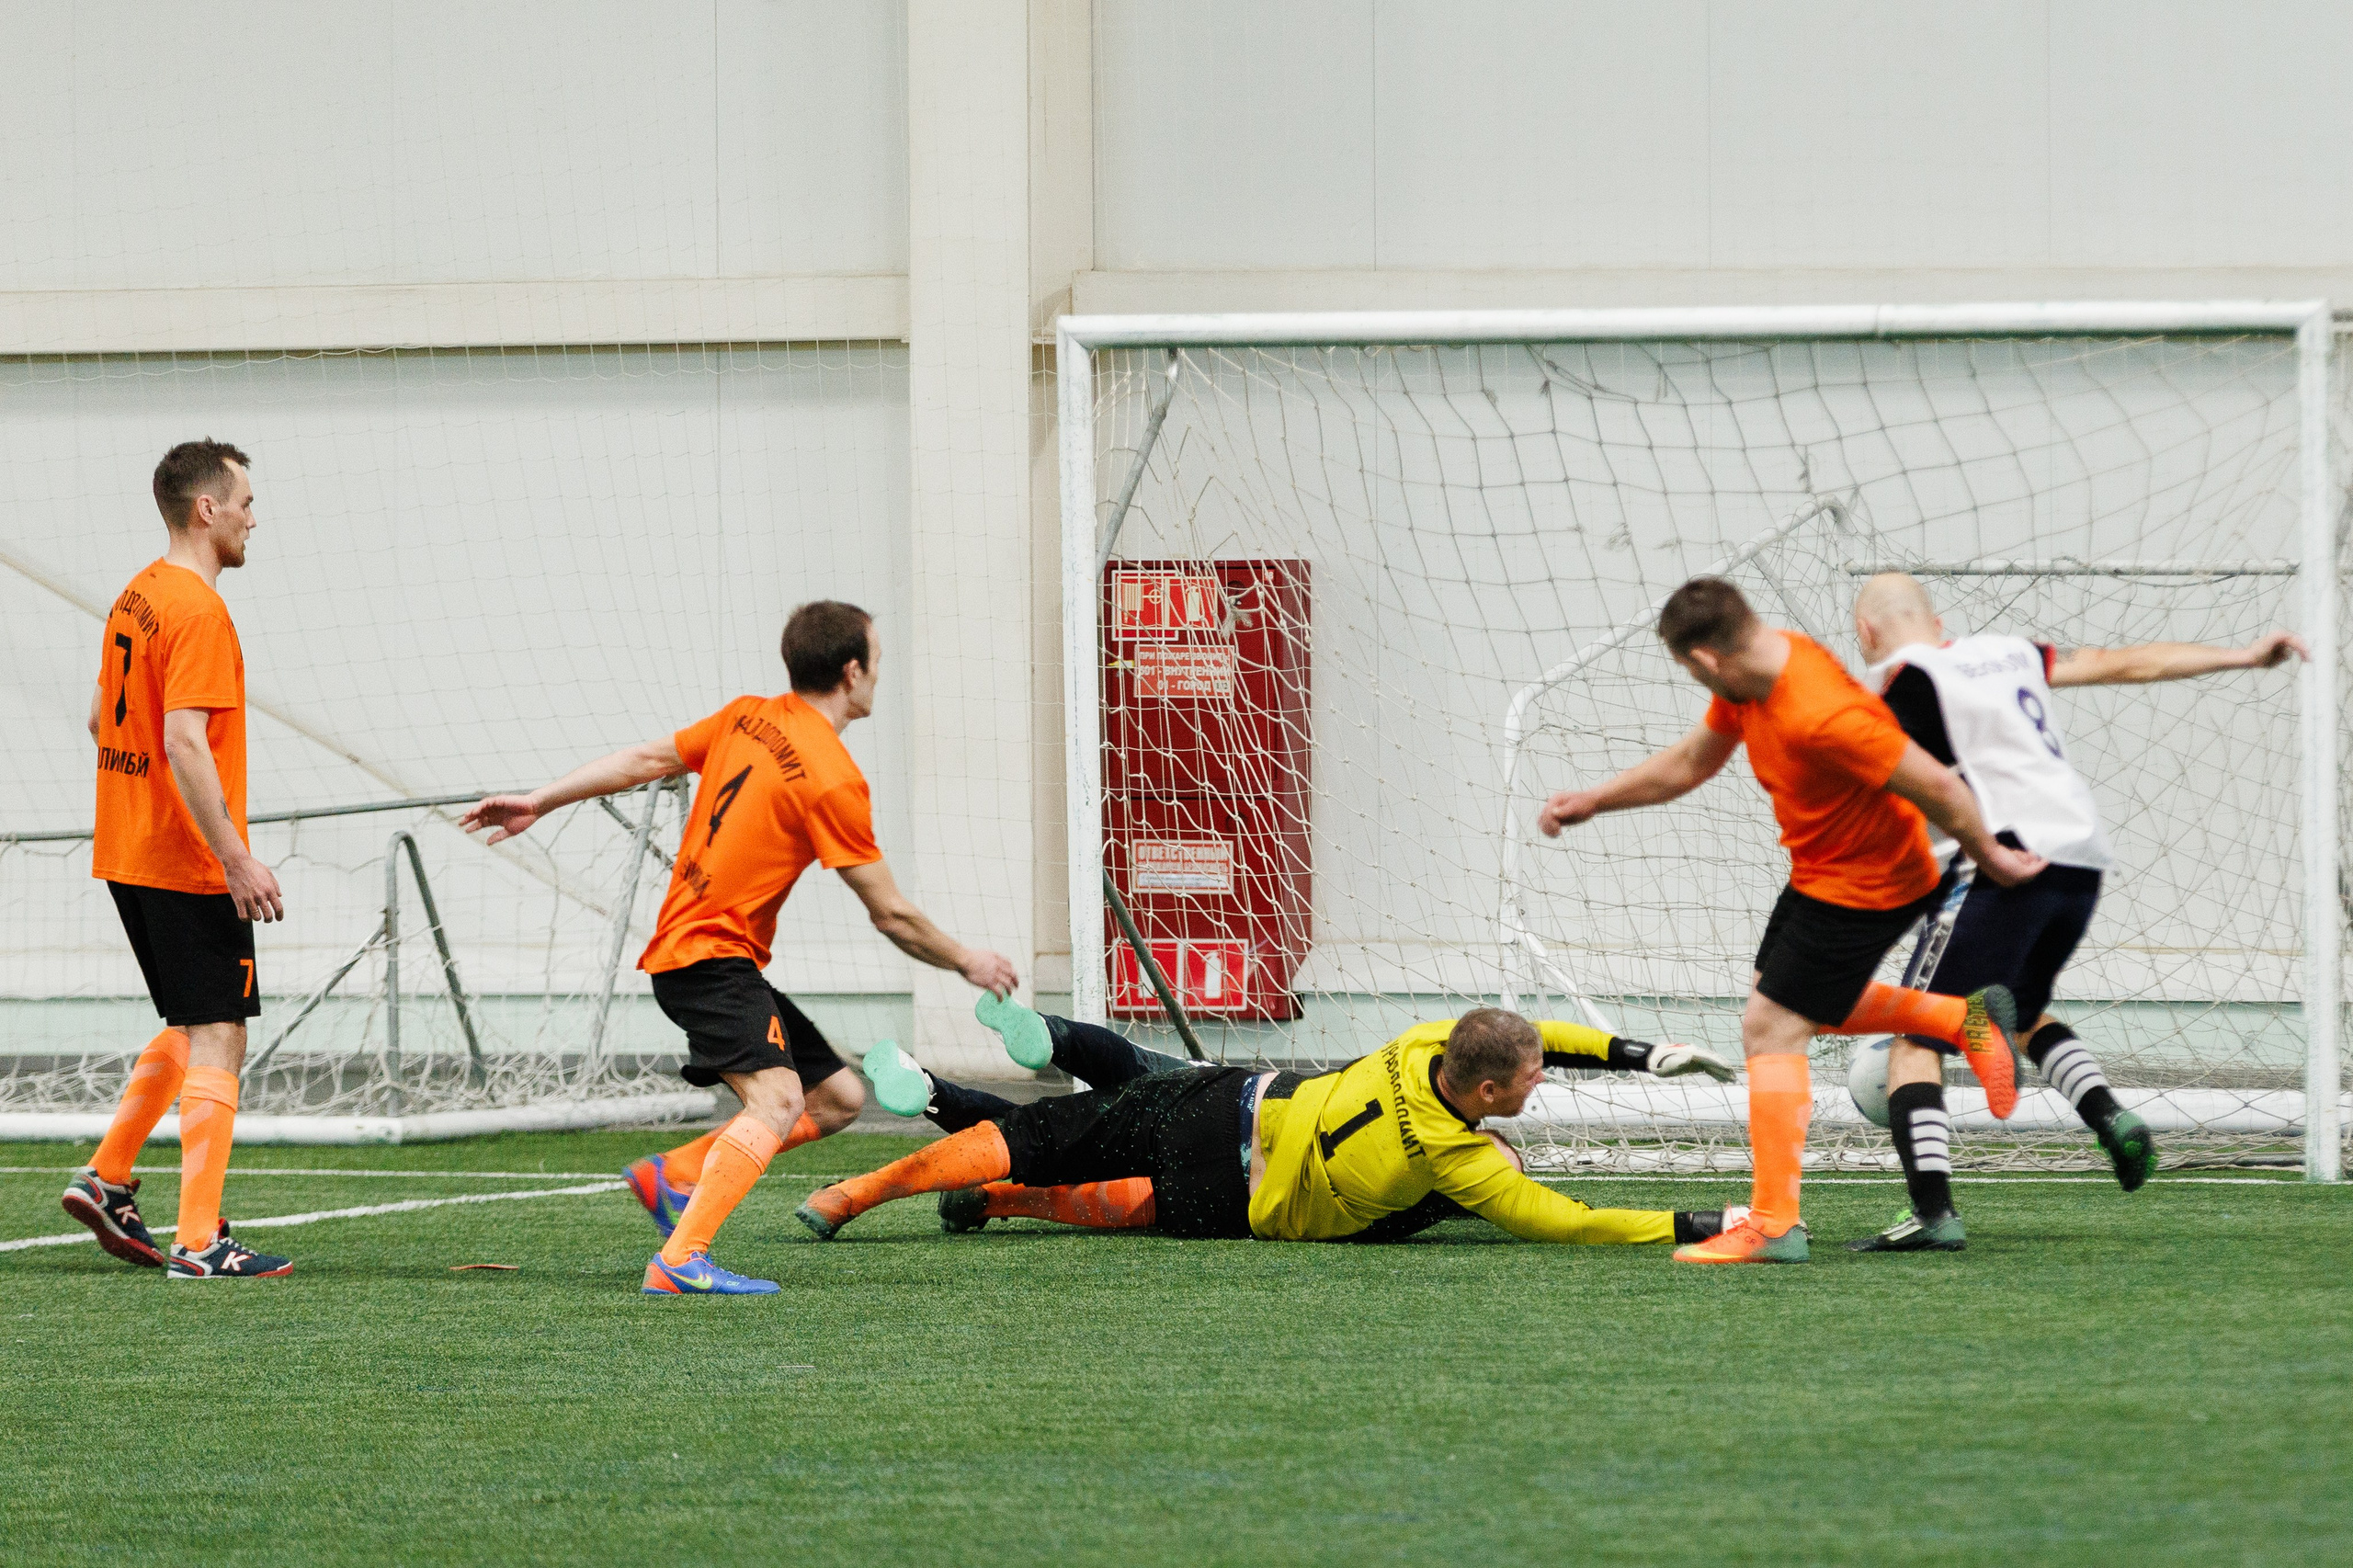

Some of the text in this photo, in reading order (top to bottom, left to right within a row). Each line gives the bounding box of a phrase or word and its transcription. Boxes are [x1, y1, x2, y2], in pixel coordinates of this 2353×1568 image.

[115, 632, 132, 727] 7
[707, 764, 754, 847] 4
[239, 959, 254, 998] 7
[767, 1015, 786, 1051] 4
[1319, 1098, 1384, 1163] 1
